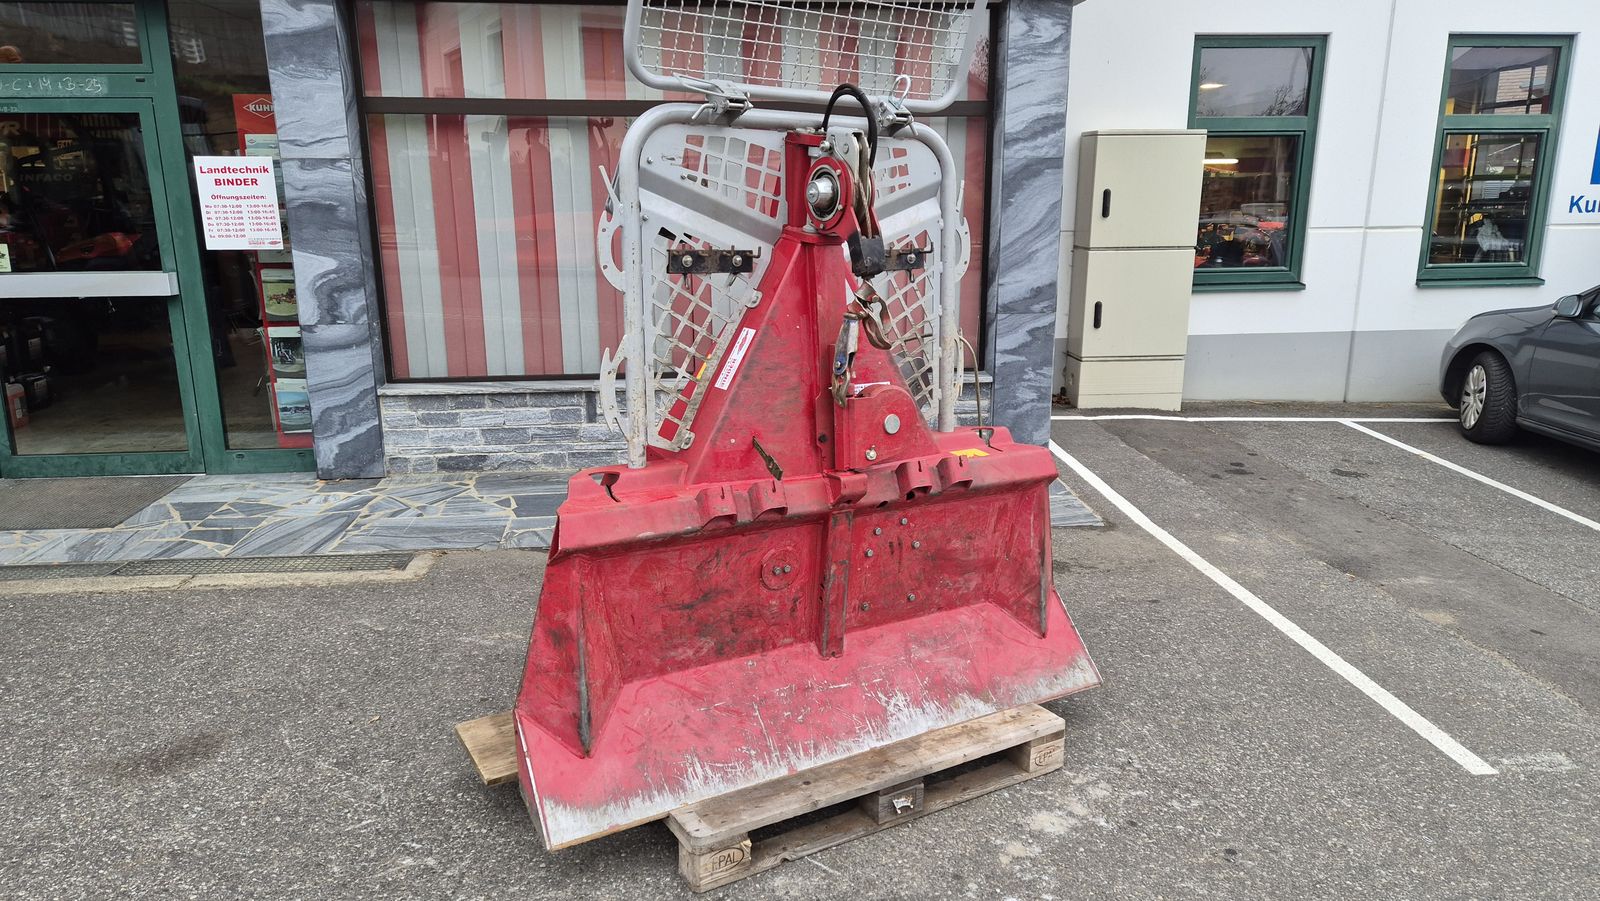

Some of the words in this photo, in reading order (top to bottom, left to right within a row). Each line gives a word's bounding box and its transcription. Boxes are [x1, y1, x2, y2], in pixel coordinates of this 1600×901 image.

[199, 165, 270, 174] Landtechnik
[214, 178, 259, 187] BINDER
[210, 193, 267, 201] Öffnungszeiten:
[1568, 195, 1600, 214] Ku
